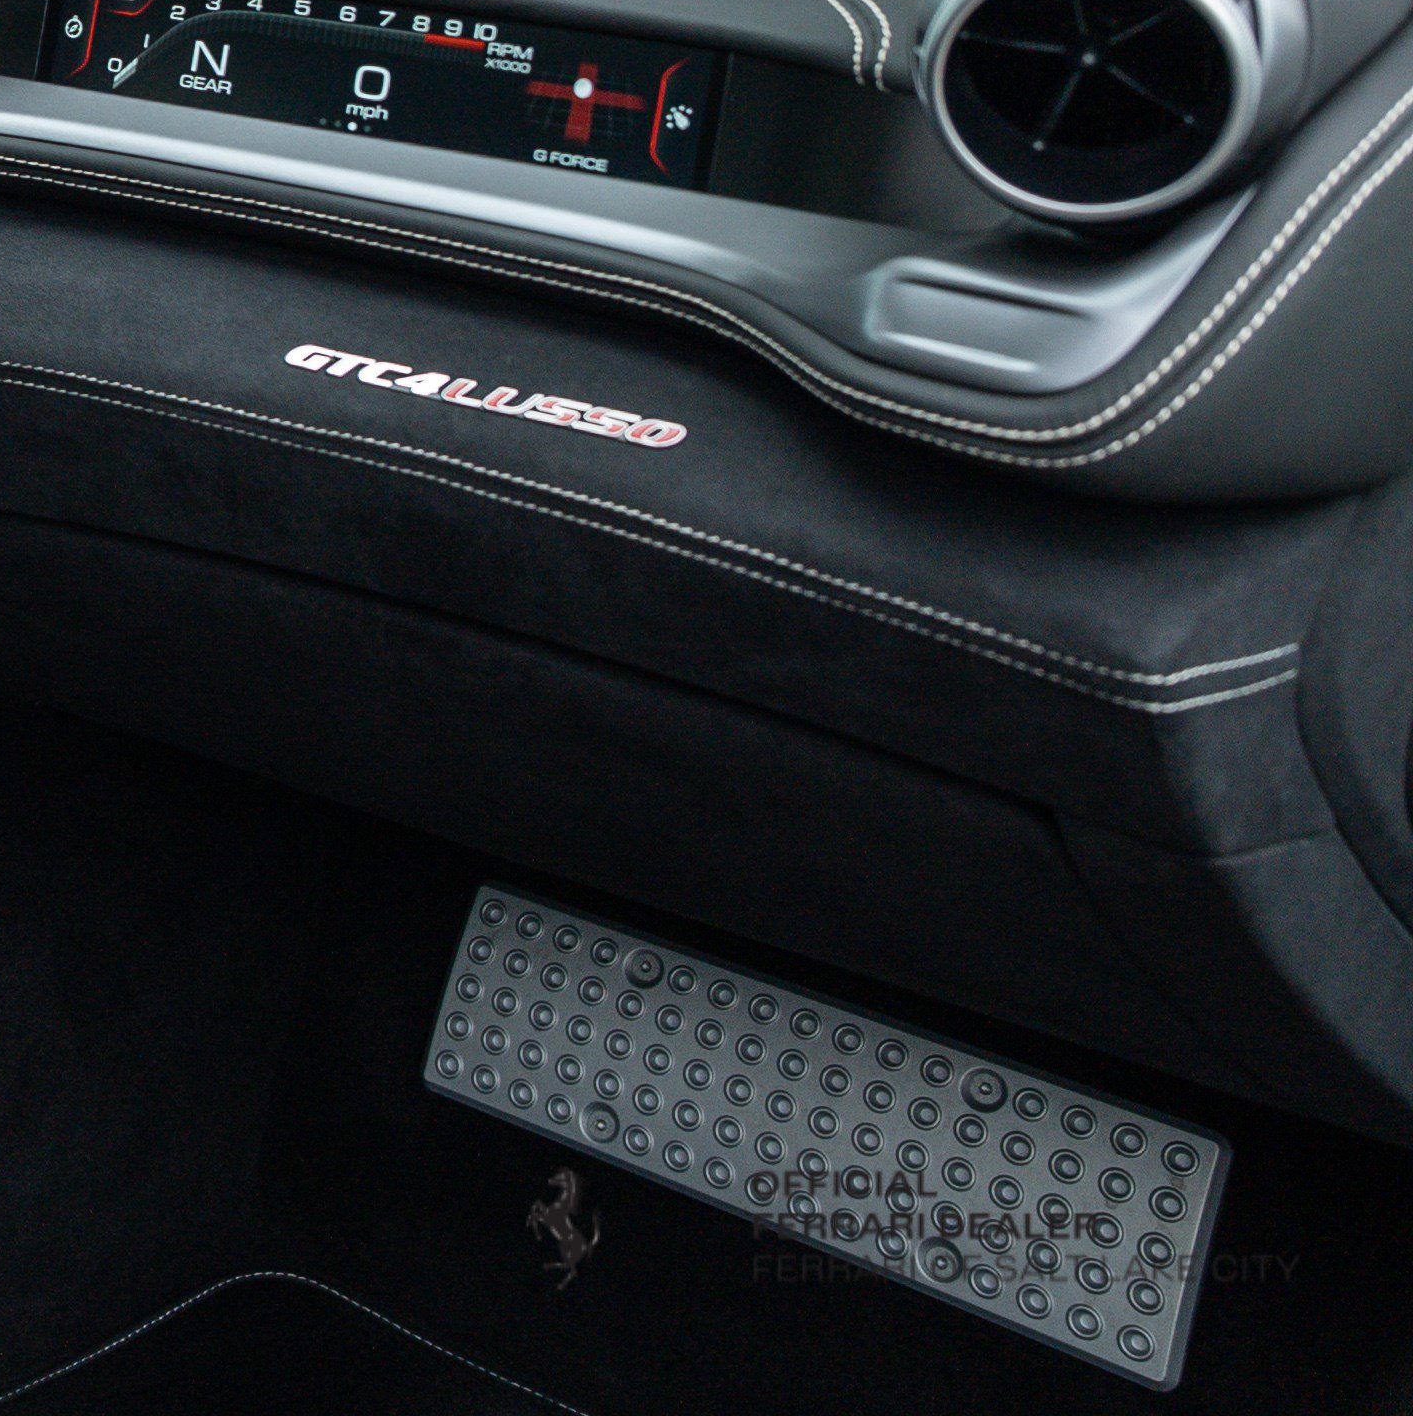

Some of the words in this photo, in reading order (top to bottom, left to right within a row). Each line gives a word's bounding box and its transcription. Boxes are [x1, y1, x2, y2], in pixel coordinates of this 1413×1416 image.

[169, 5, 186, 22] 2
[293, 0, 312, 17] 5
[339, 5, 357, 23] 6
[378, 10, 396, 28] 7
[412, 15, 431, 33] 8
[444, 19, 463, 37] 9
[473, 23, 498, 42] 10
[189, 39, 231, 76] N
[487, 42, 534, 61] RPM
[107, 57, 123, 74] 0
[179, 74, 233, 95] GEAR
[352, 65, 392, 102] 0
[345, 102, 389, 122] mph
[533, 149, 548, 163] G
[549, 151, 609, 173] FORCE
[284, 343, 688, 448] GTC4LUSSO
